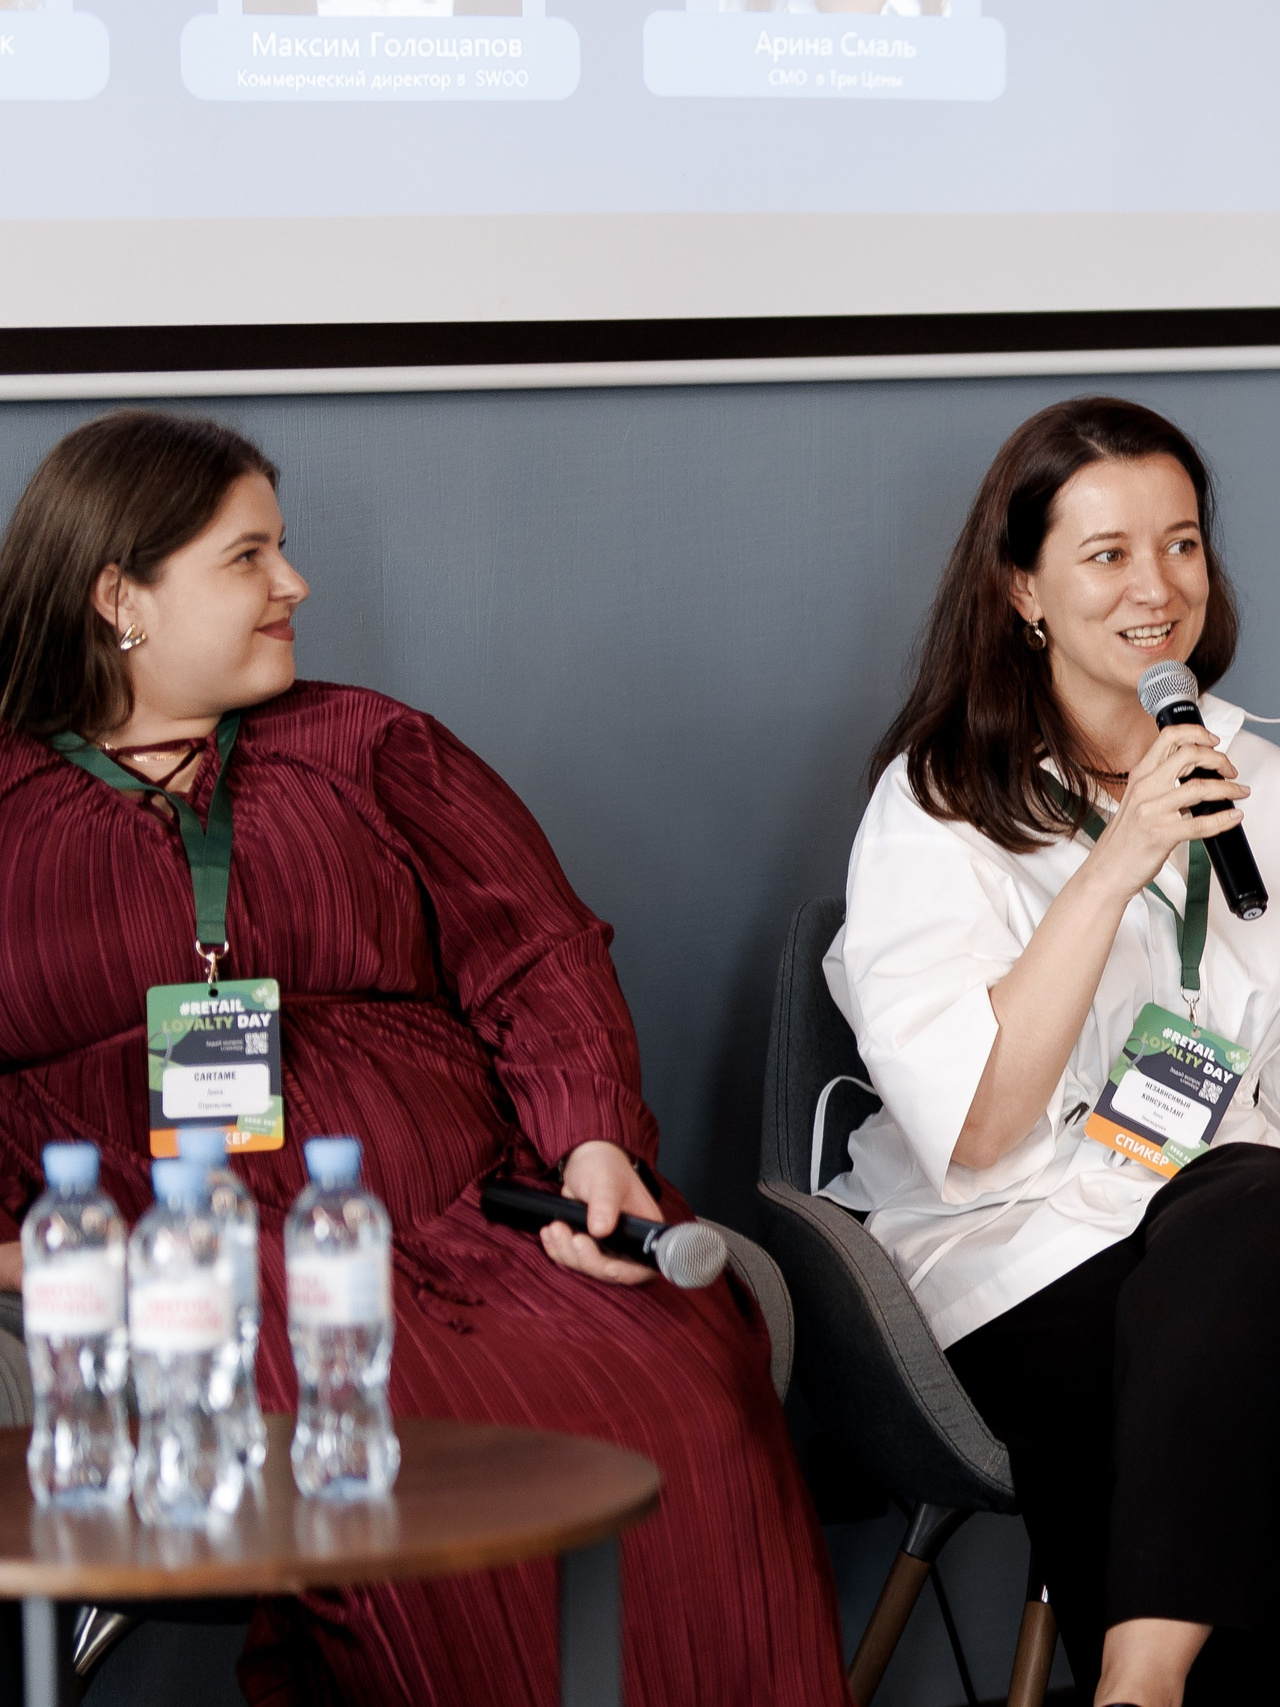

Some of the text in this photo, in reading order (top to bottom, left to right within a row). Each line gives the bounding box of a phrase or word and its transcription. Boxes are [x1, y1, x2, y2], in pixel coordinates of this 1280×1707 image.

[251, 31, 523, 61] Максим Голощапов
[754, 30, 918, 63] Арина Смаль
[237, 69, 529, 91] Коммерческий директор в SWOO
[815, 73, 824, 87] в
[829, 69, 857, 91] Три
[861, 69, 904, 91] Цены
[179, 999, 246, 1016] #RETAIL
[161, 1013, 273, 1034] LOYALTY DAY
[1141, 1031, 1234, 1085] LOYALTY DAY
[1162, 1027, 1216, 1062] #RETAIL
[1141, 1092, 1184, 1119] КОНСУЛЬТАНТ
[1145, 1081, 1192, 1109] НЕЗАВИСИМЫЙ
[1115, 1133, 1170, 1167] СПИКЕР
